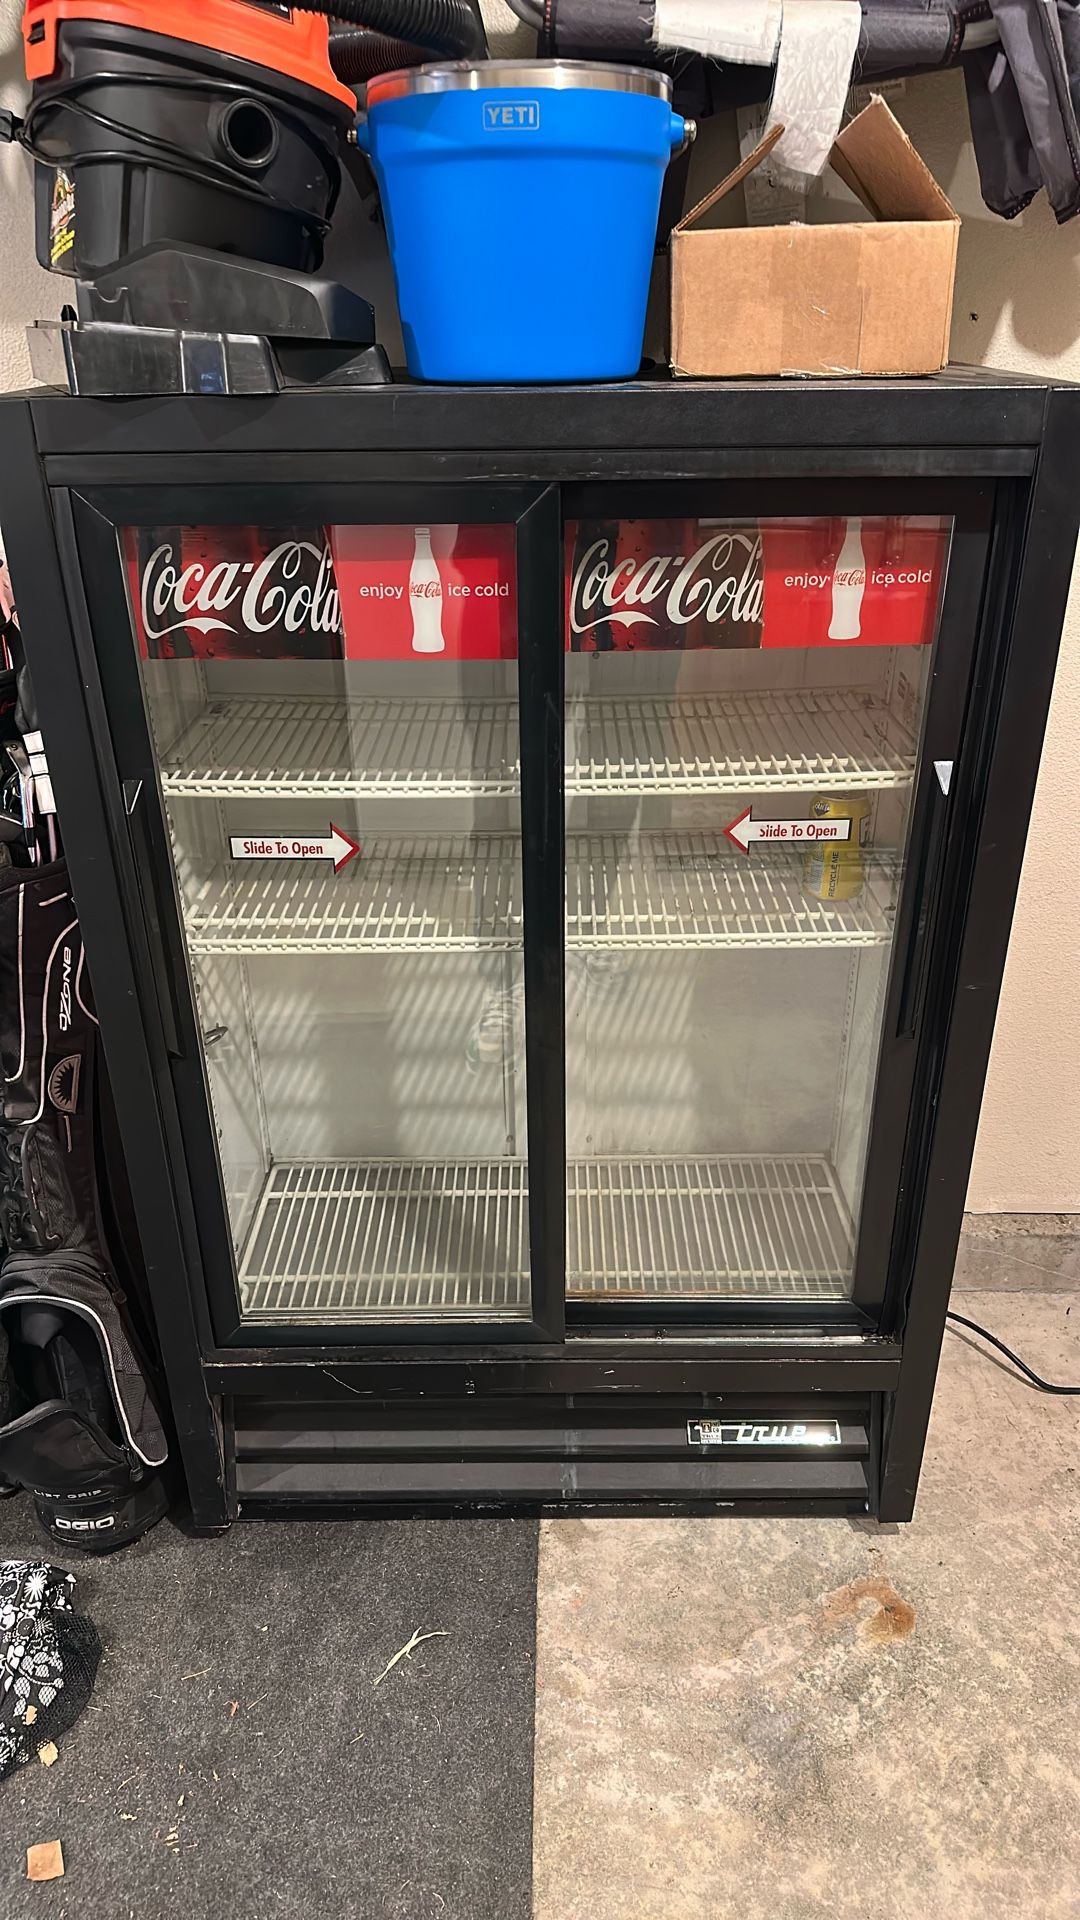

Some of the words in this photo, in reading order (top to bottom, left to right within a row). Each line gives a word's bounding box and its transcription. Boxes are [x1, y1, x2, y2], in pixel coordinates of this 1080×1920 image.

[487, 106, 535, 124] YETI
[570, 534, 764, 634] Coca-Cola
[784, 572, 827, 589] enjoy
[871, 570, 894, 585] ice
[898, 569, 933, 584] cold
[142, 541, 343, 640] Coca-Cola
[360, 582, 404, 600] enjoy
[448, 582, 471, 597] ice
[474, 582, 510, 597] cold
[759, 824, 788, 837] Slide
[791, 825, 803, 837] To
[806, 824, 837, 840] Open
[243, 841, 273, 854] Slide
[275, 841, 289, 854] To
[292, 841, 324, 857] Open
[832, 851, 840, 863] ME
[828, 864, 838, 897] RECYCLE
[55, 1515, 115, 1530] OGIO
